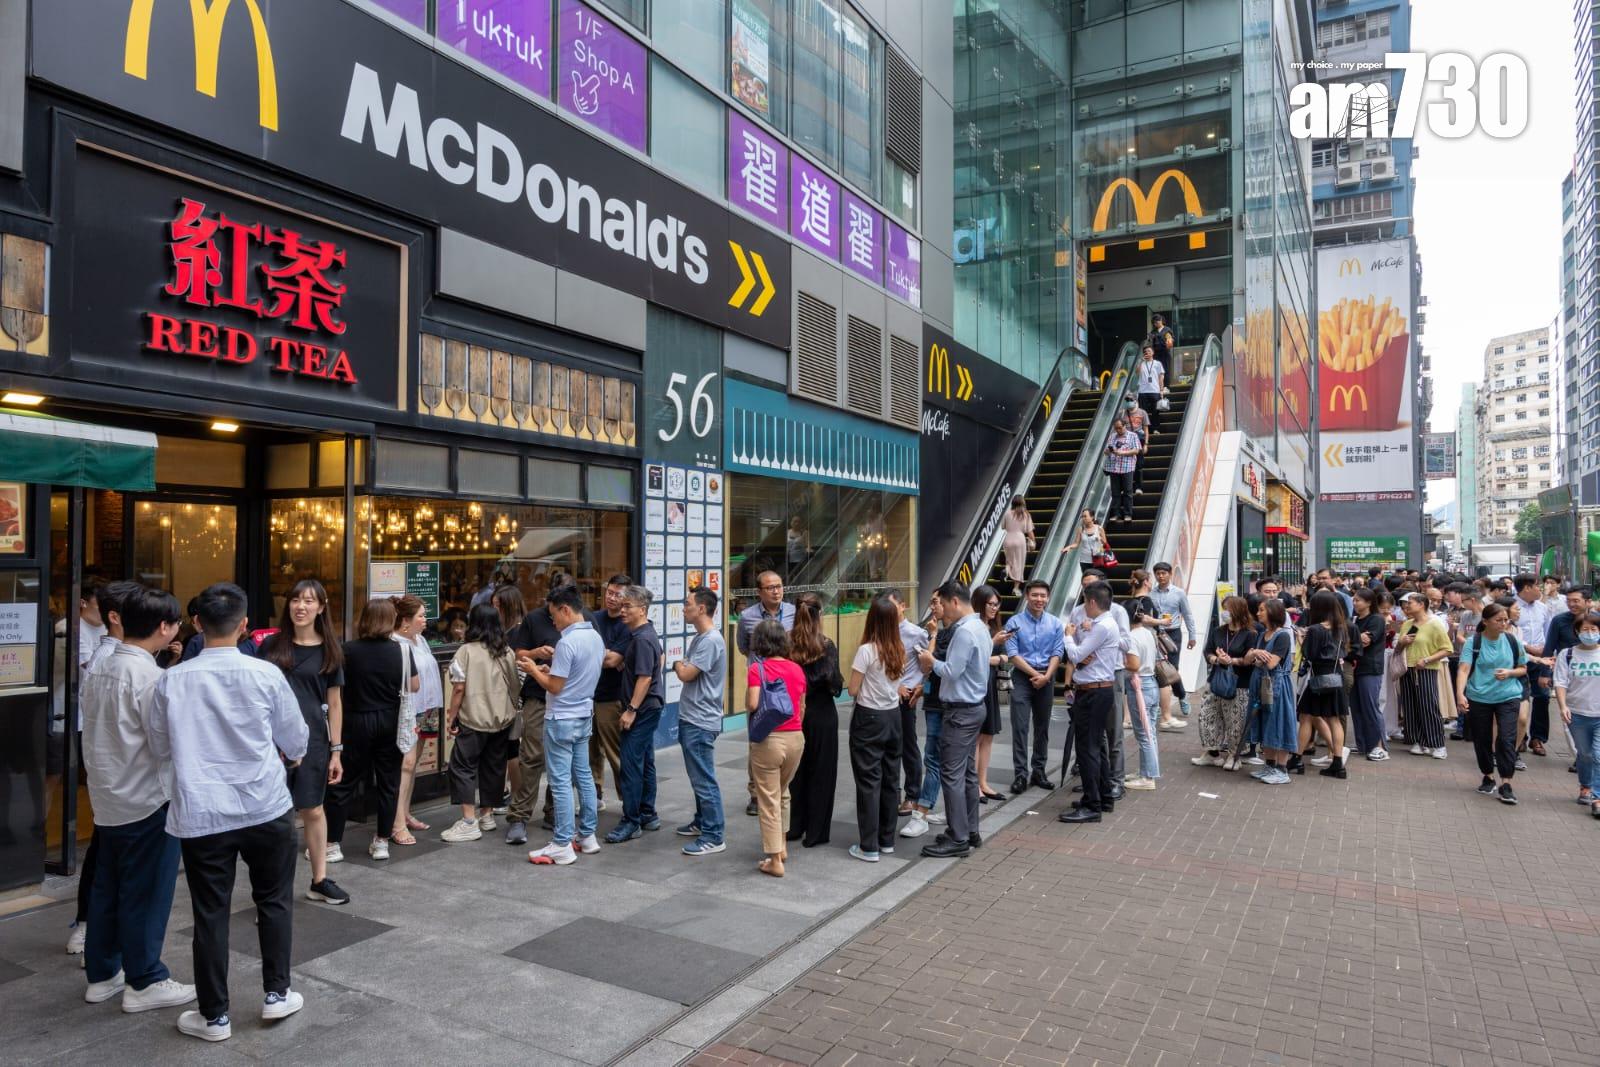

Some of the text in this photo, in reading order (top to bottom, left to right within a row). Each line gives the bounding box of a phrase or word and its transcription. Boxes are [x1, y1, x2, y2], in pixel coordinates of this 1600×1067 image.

[575, 11, 603, 40] 1/F
[574, 40, 635, 94] Shop A
[340, 62, 709, 285] McDonald's
[164, 196, 347, 335] 紅茶
[145, 312, 358, 384] RED TEA
[659, 372, 718, 442] 56
[922, 409, 950, 441] McCafé
[969, 483, 1011, 572] McDonald's
[6, 633, 22, 641] Only
